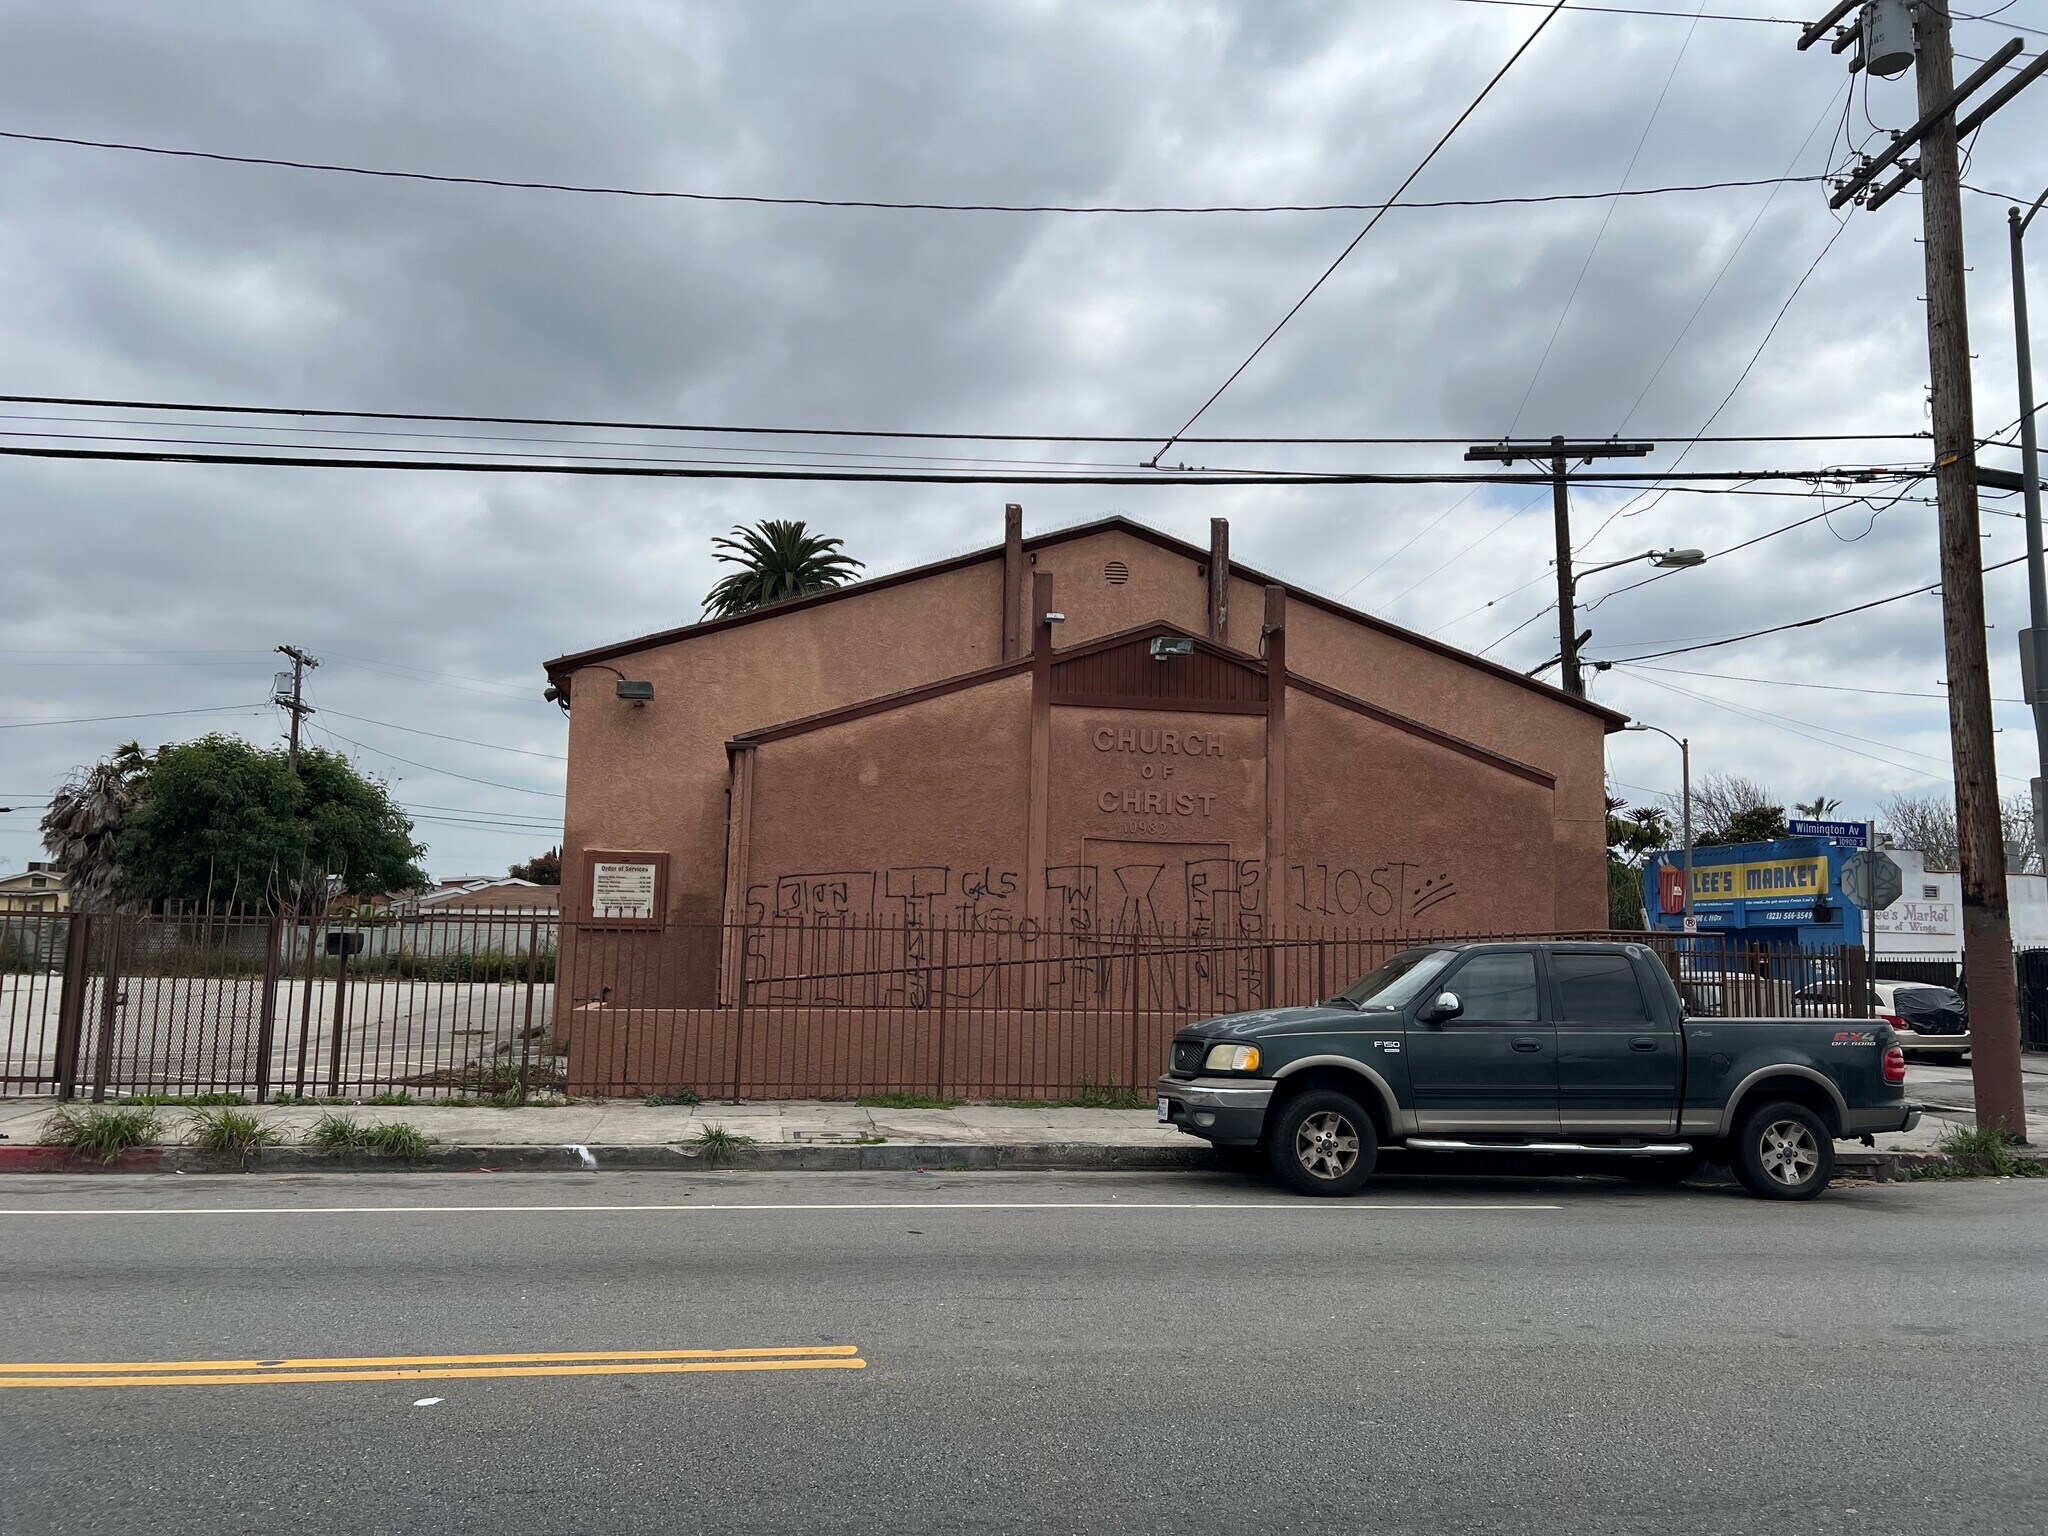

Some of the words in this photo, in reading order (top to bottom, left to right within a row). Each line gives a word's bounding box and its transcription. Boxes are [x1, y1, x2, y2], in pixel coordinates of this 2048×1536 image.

[1093, 727, 1225, 756] CHURCH
[1141, 764, 1174, 779] OF
[1098, 789, 1216, 816] CHRIST
[1124, 821, 1168, 835] 10982
[1796, 823, 1845, 836] Wilmington
[1848, 825, 1860, 835] Av
[1693, 871, 1732, 893] LEE'S
[1747, 864, 1819, 890] MARKET
[1904, 904, 1948, 922] Market
[1895, 922, 1903, 931] of
[1909, 922, 1937, 933] Wings
[1832, 1032, 1875, 1041] FX4
